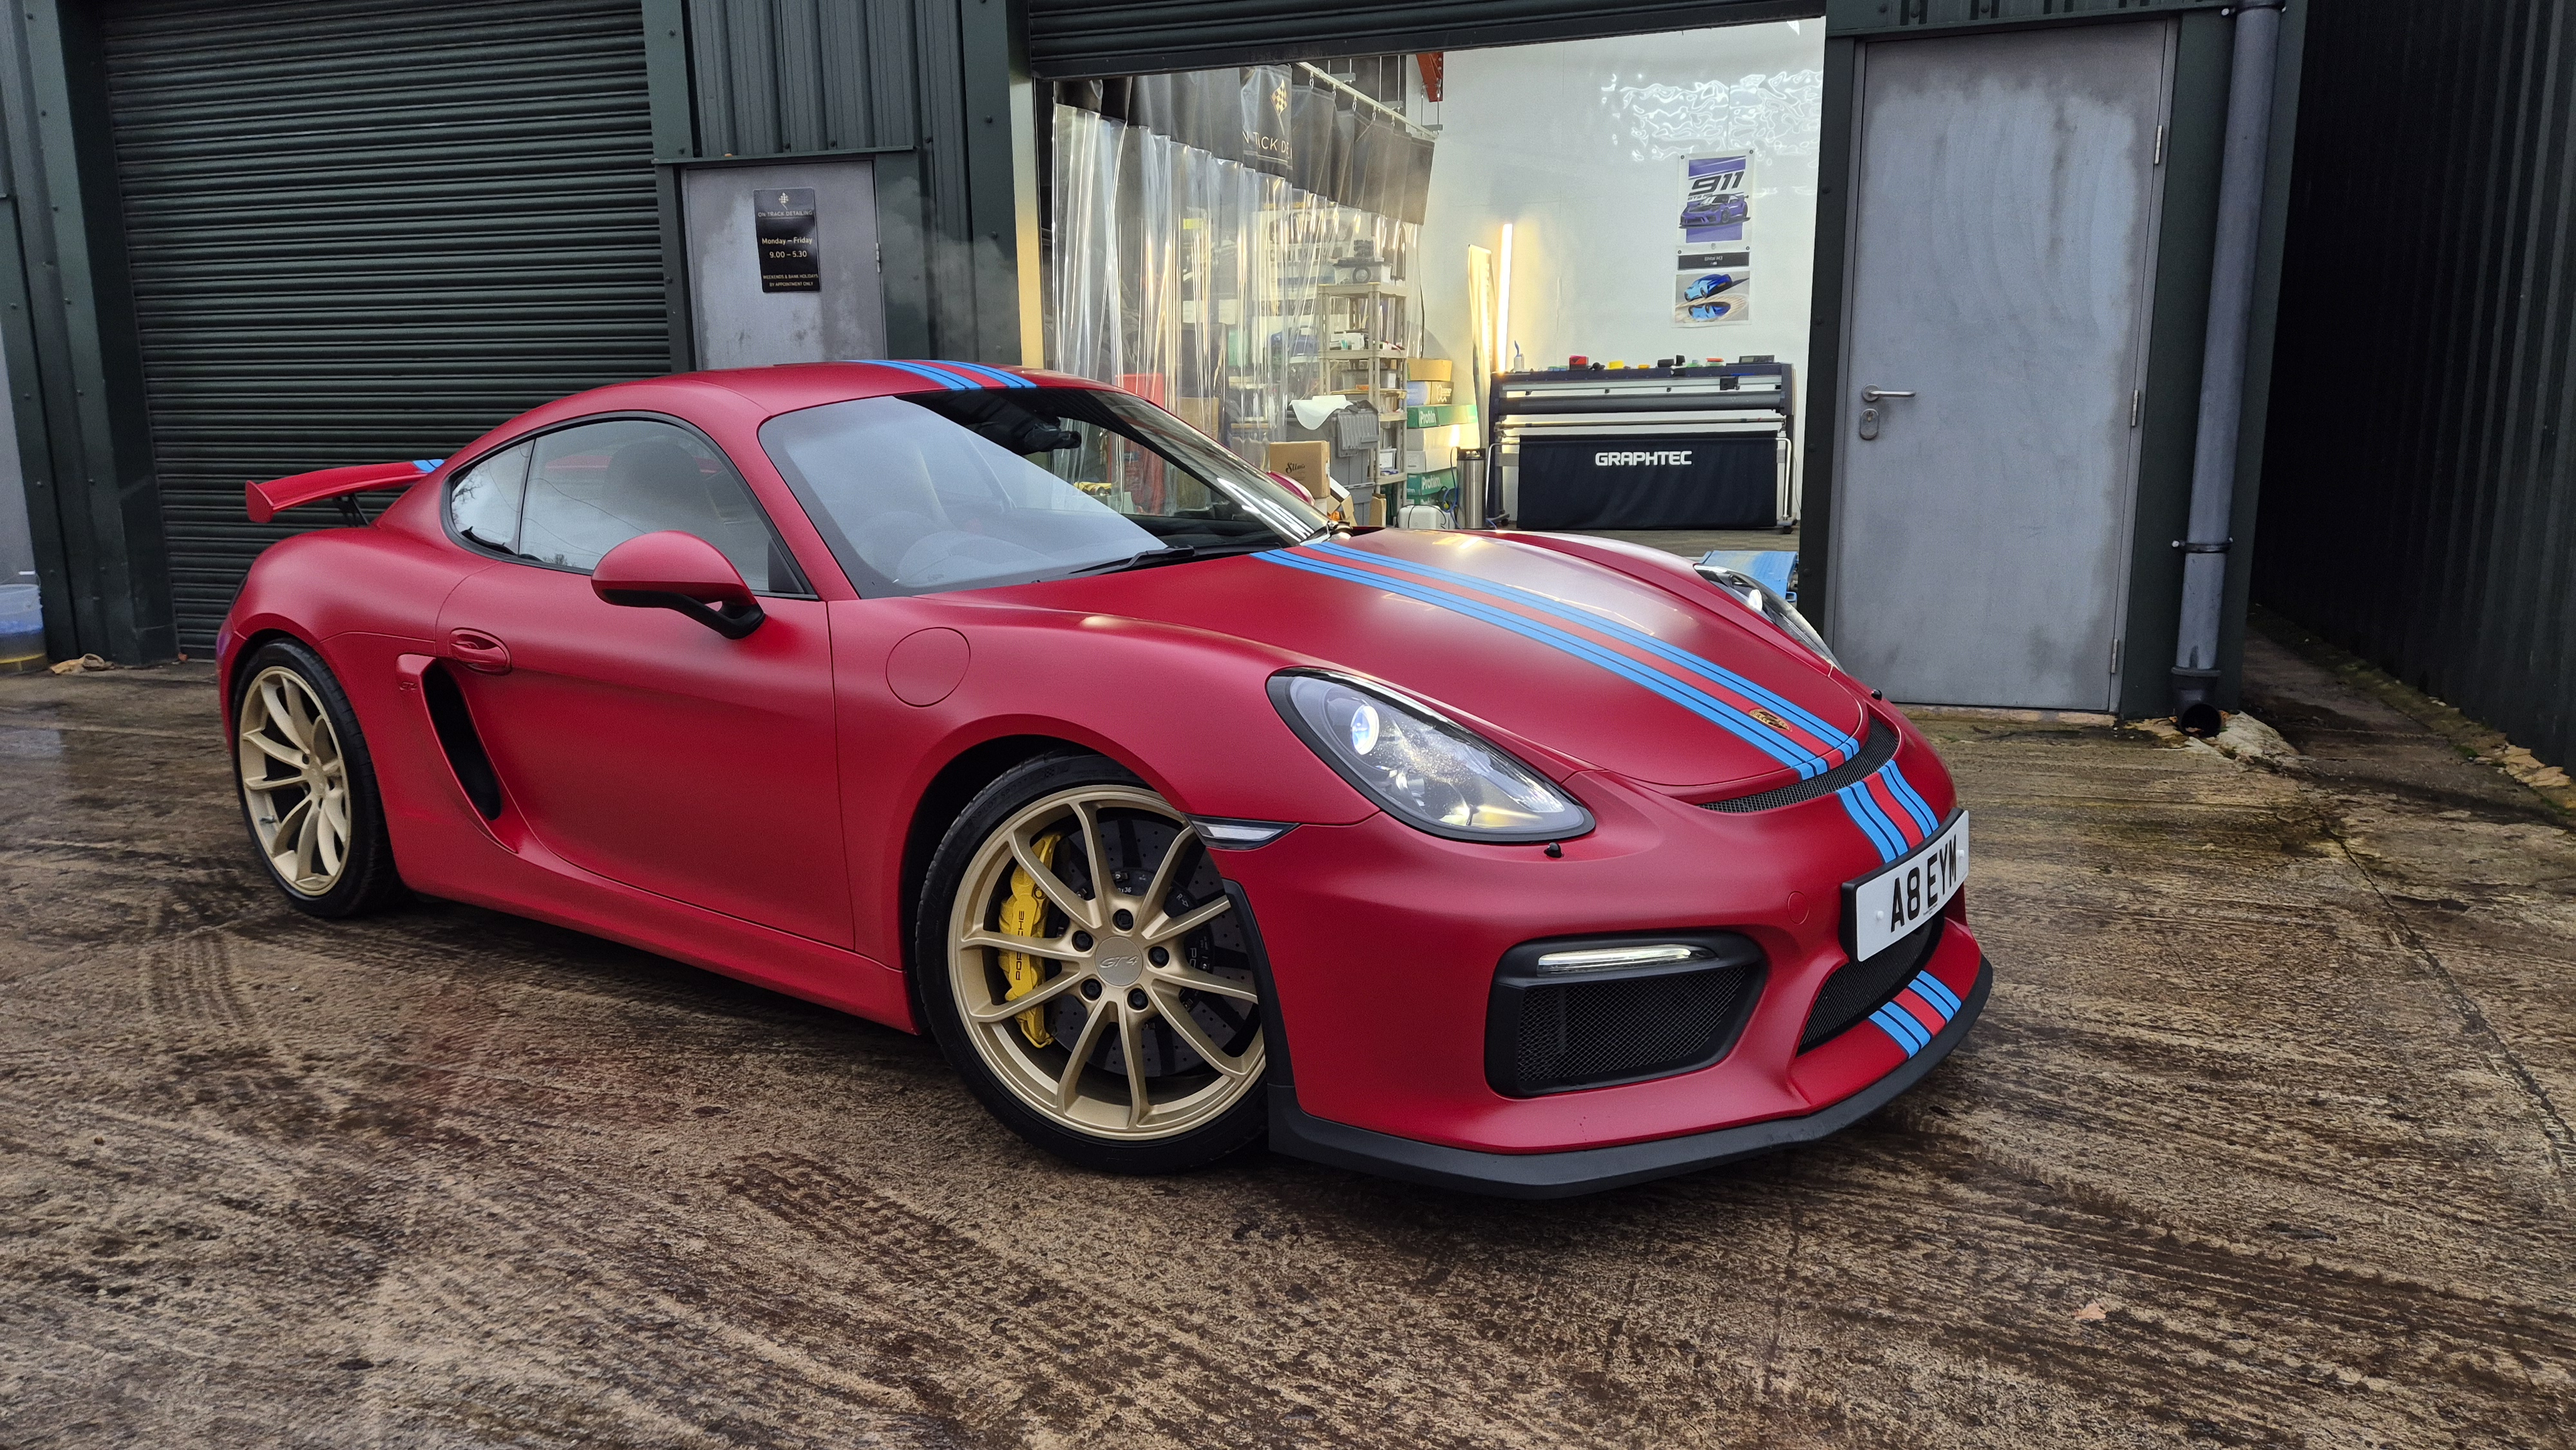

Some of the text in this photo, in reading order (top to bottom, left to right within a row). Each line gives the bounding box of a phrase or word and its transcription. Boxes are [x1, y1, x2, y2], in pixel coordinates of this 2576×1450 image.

[1688, 171, 1745, 197] 911
[1595, 450, 1692, 466] GRAPHTEC
[1890, 833, 1957, 933] A8 EYM
